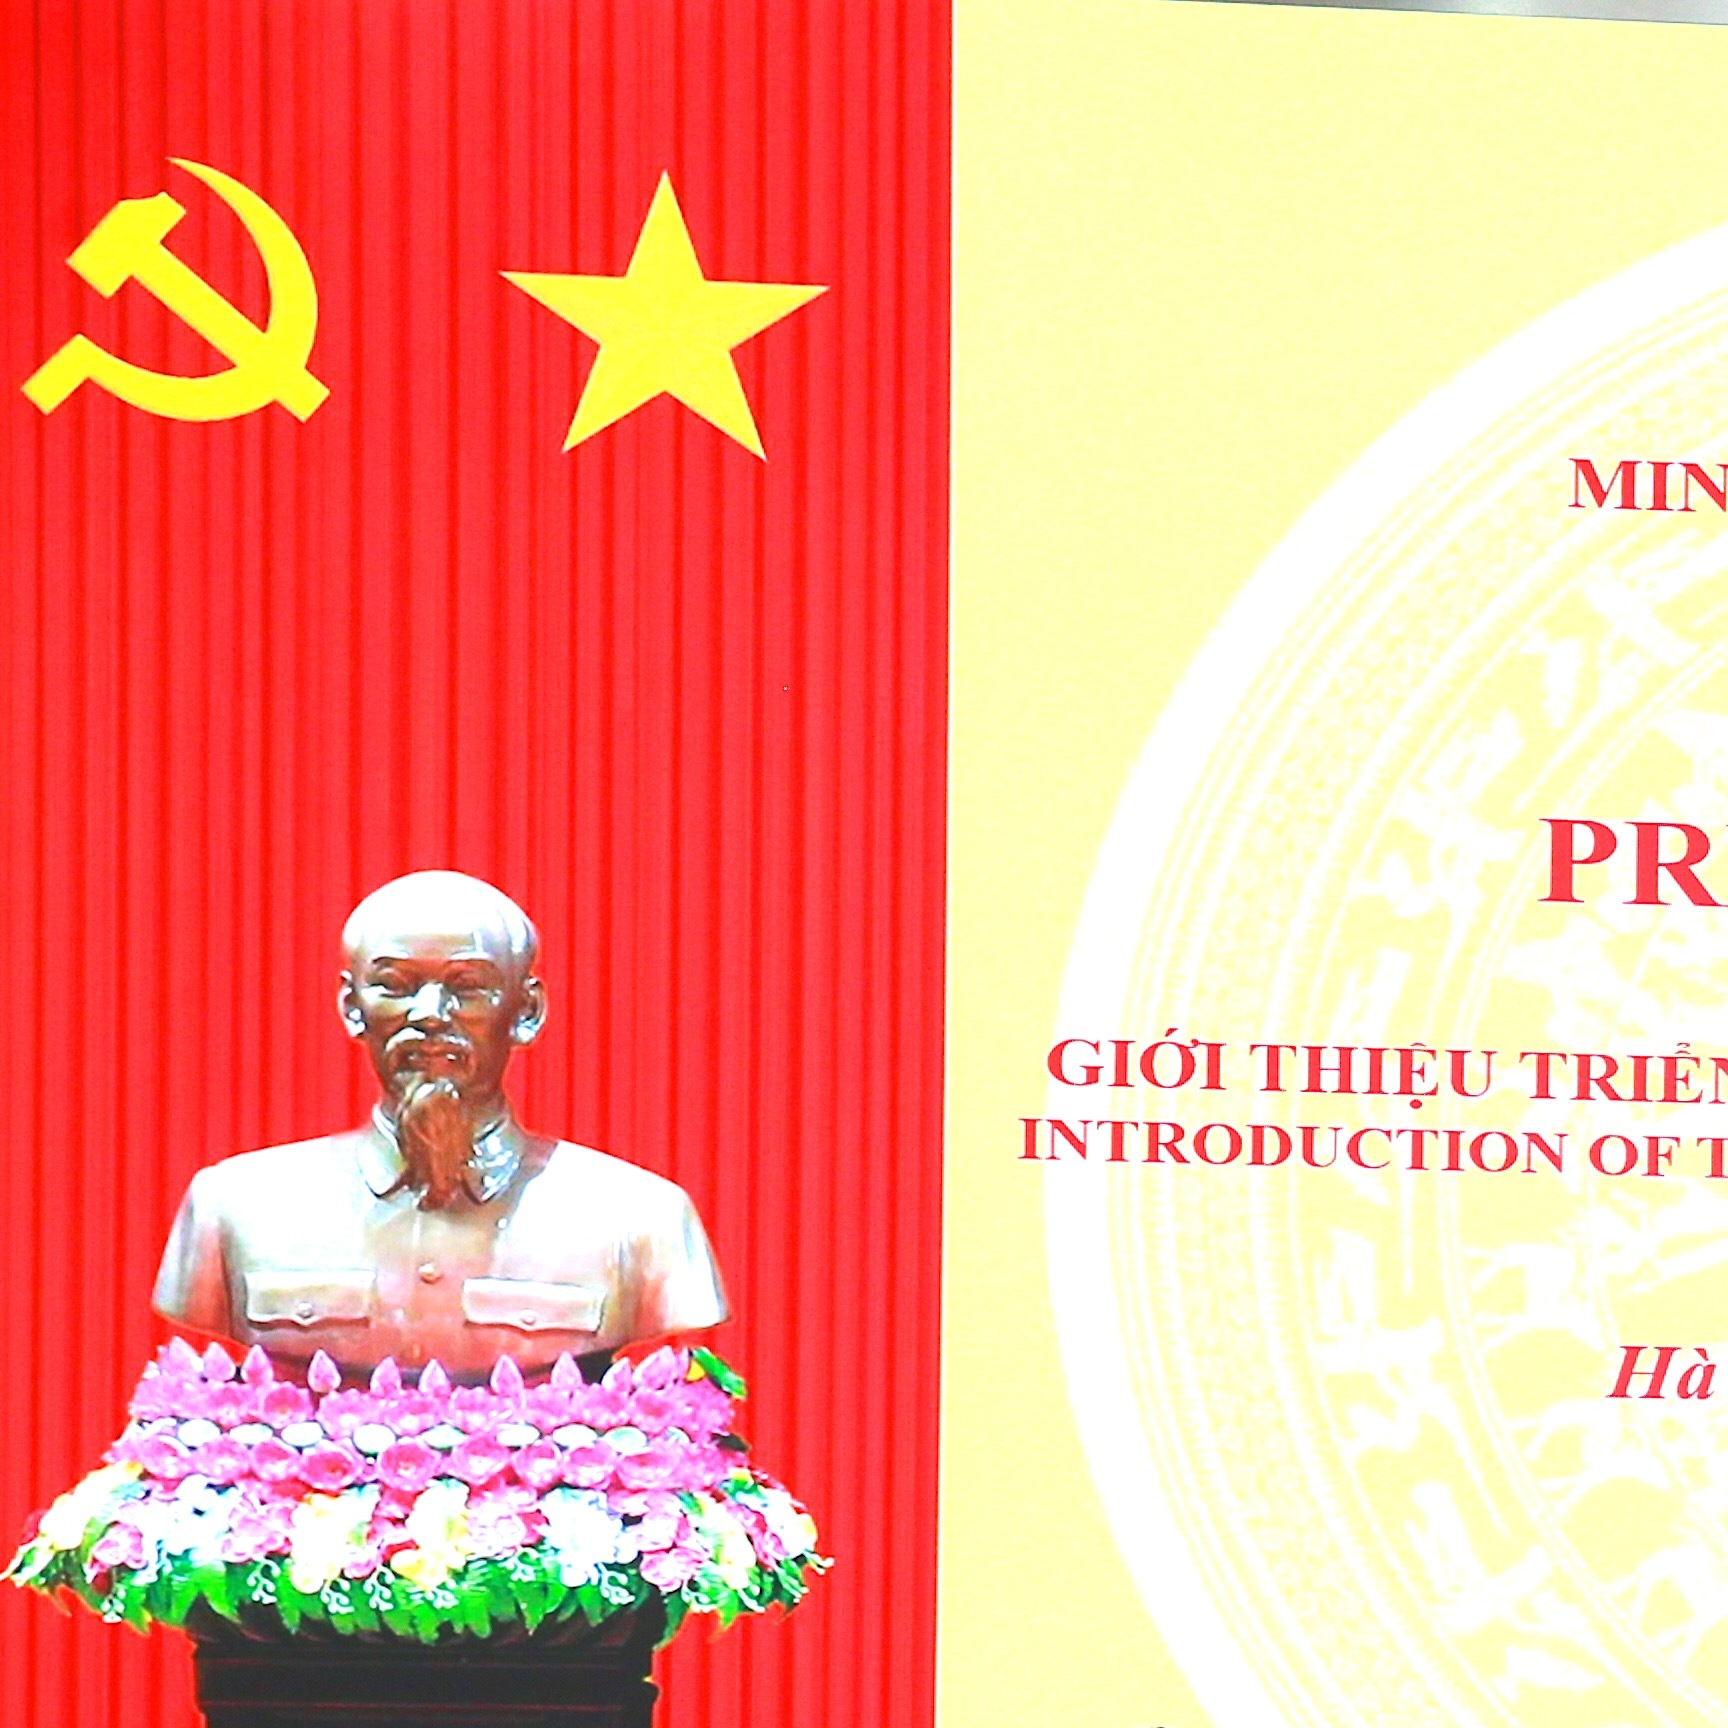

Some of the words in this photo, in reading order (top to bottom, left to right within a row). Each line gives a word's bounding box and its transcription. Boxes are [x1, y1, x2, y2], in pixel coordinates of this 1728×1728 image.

[1046, 1026, 1227, 1092] GIỚI
[1248, 1041, 1498, 1111] THIỆU
[1018, 1116, 1570, 1175] INTRODUCTION
[1587, 1133, 1682, 1178] OF
[1606, 1344, 1718, 1402] Hà
